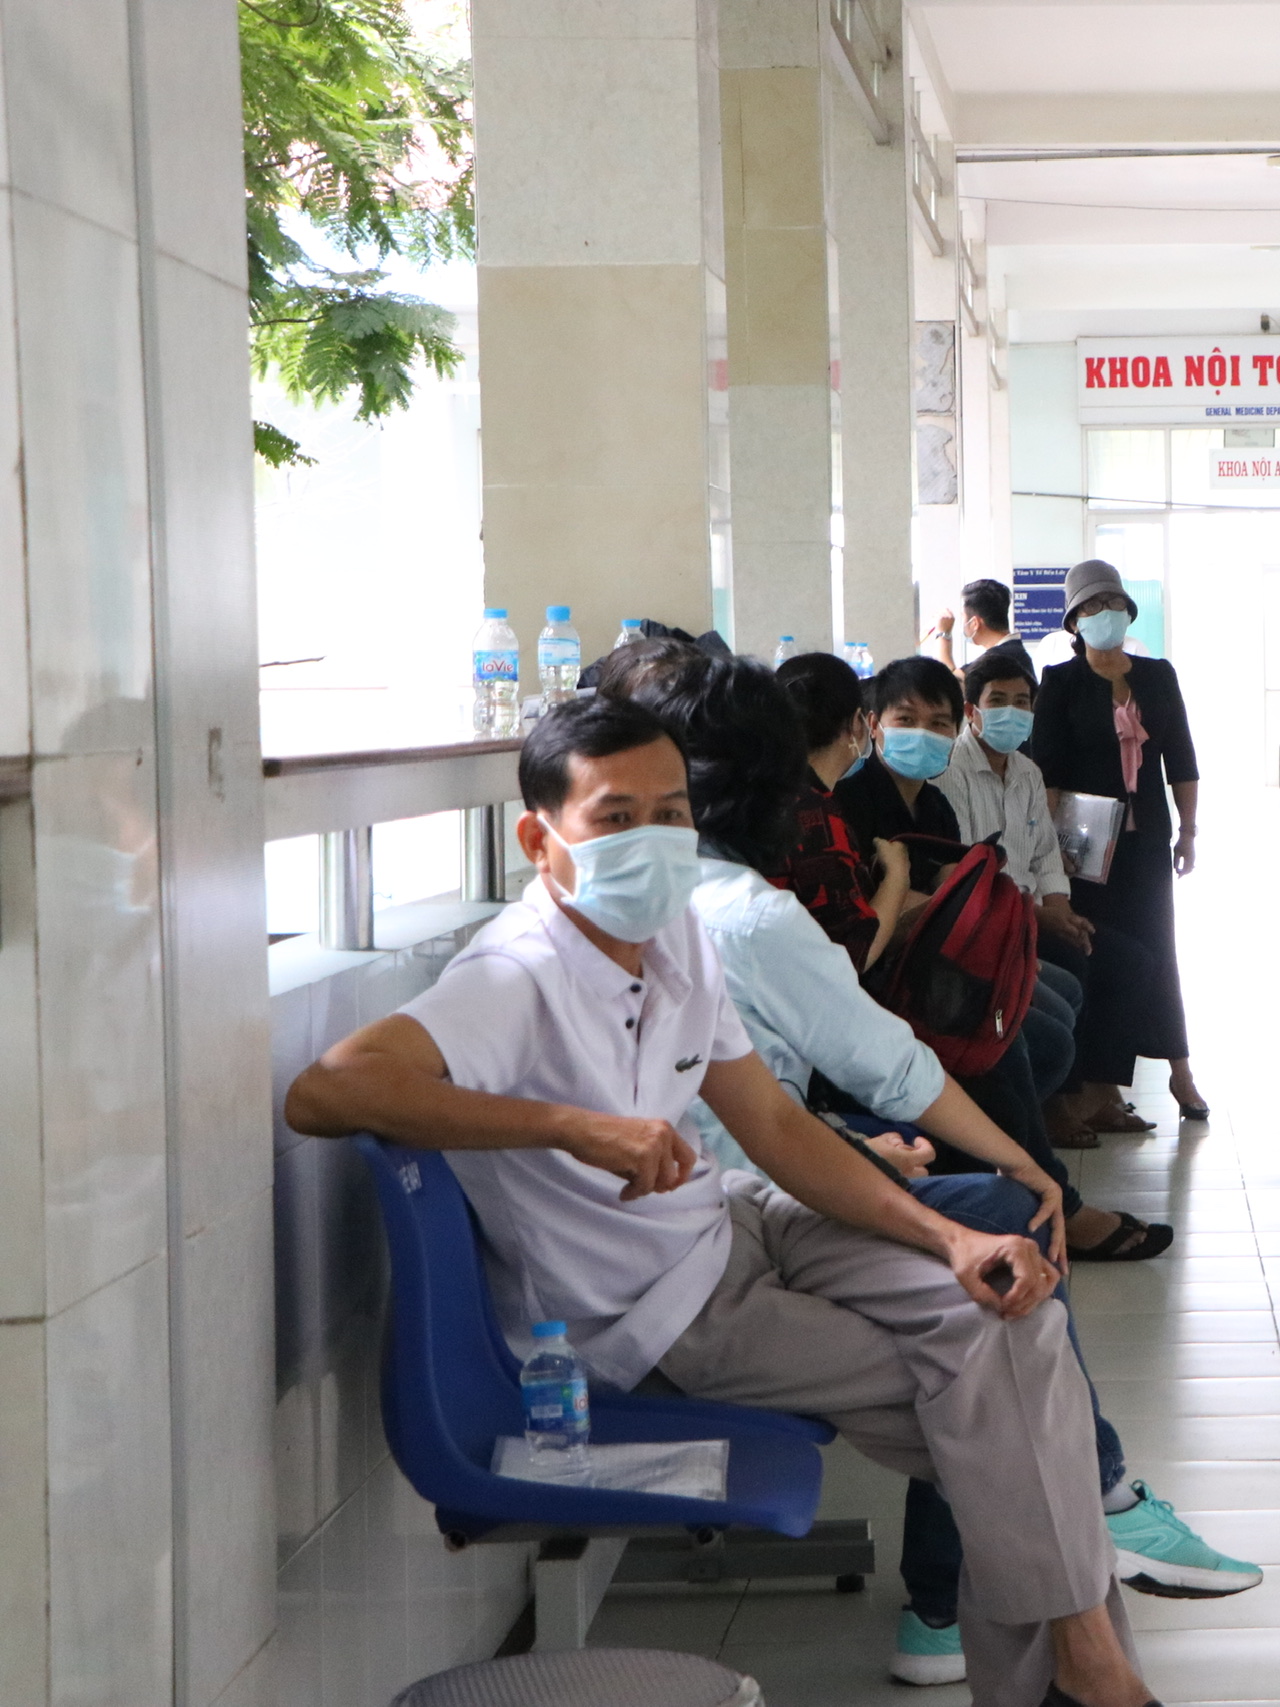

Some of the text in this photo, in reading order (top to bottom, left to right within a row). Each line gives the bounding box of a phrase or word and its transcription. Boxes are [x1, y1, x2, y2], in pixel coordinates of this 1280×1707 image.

[1085, 356, 1173, 389] KHOA
[1184, 346, 1241, 396] NỘI
[1205, 407, 1232, 417] GENERAL
[1235, 406, 1264, 416] MEDICINE
[1218, 461, 1248, 477] KHOA
[1252, 456, 1271, 481] NỘI
[482, 660, 514, 673] laVie
